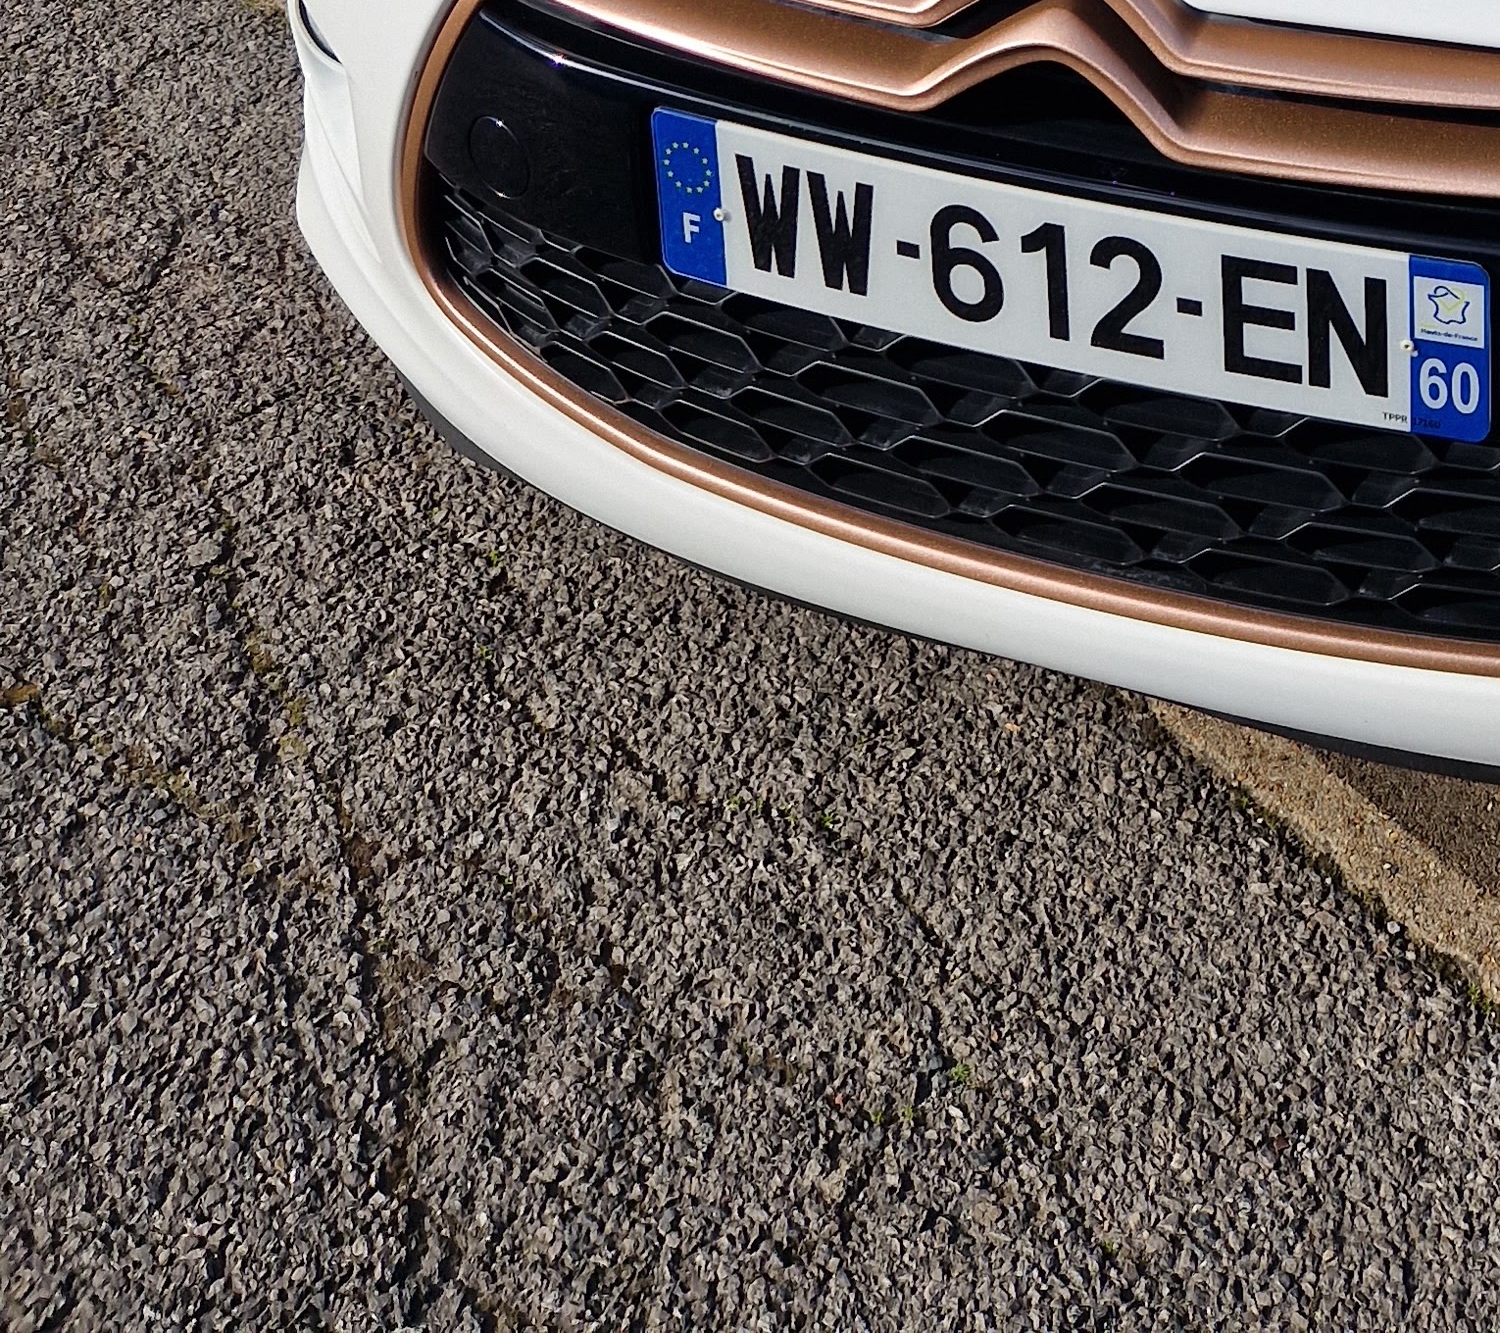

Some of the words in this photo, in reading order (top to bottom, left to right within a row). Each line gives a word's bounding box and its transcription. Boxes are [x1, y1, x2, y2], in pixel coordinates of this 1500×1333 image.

[683, 213, 701, 245] F
[734, 151, 1389, 400] WW-612-EN
[1419, 357, 1480, 414] 60
[1382, 412, 1408, 424] TPPR
